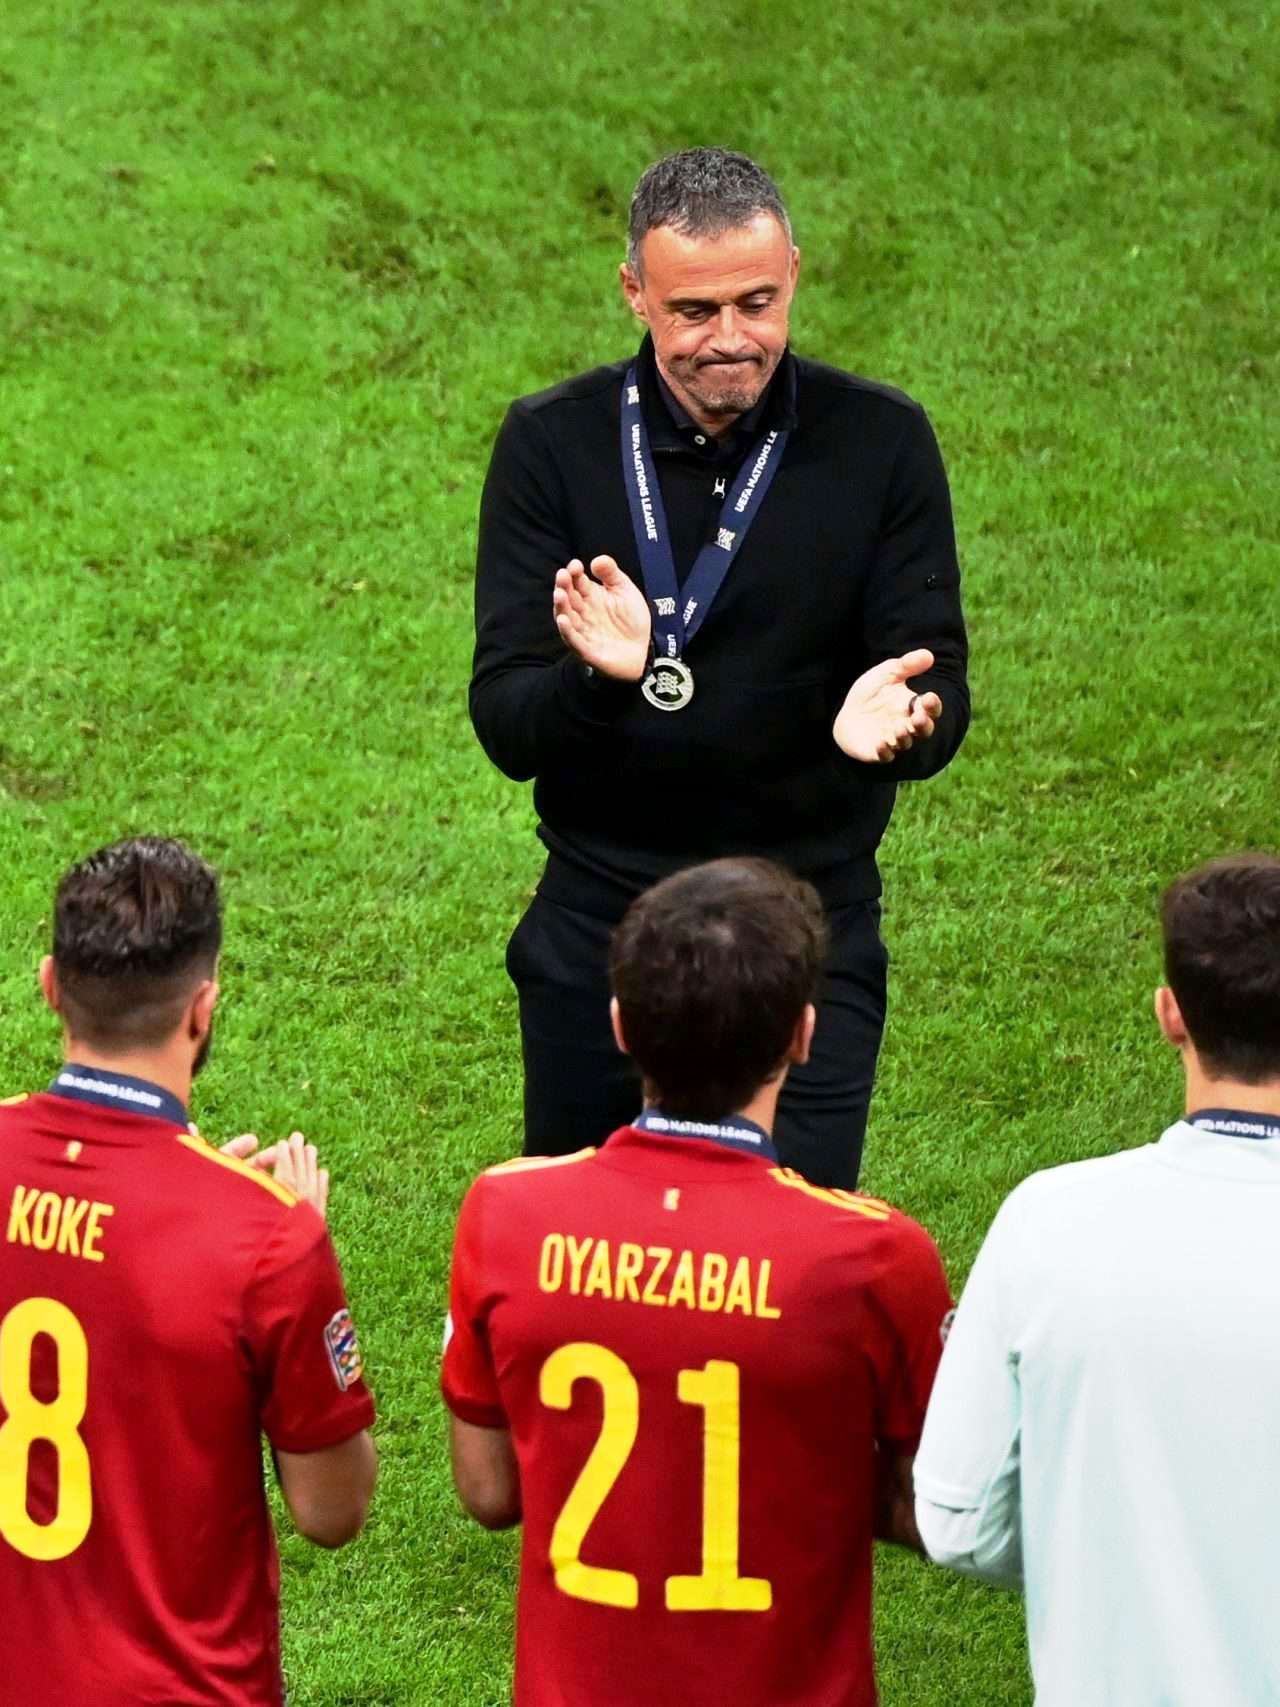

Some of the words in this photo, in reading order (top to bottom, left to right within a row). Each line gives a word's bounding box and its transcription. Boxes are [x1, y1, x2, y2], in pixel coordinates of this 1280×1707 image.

[631, 423, 641, 451] UEFA
[633, 451, 650, 498] NATIONS
[734, 486, 754, 513] UEFA
[746, 444, 772, 489] NATIONS
[640, 497, 657, 541] LEAGUE
[6, 1184, 114, 1263] KOKE
[538, 1232, 782, 1320] OYARZABAL
[539, 1341, 773, 1612] 21
